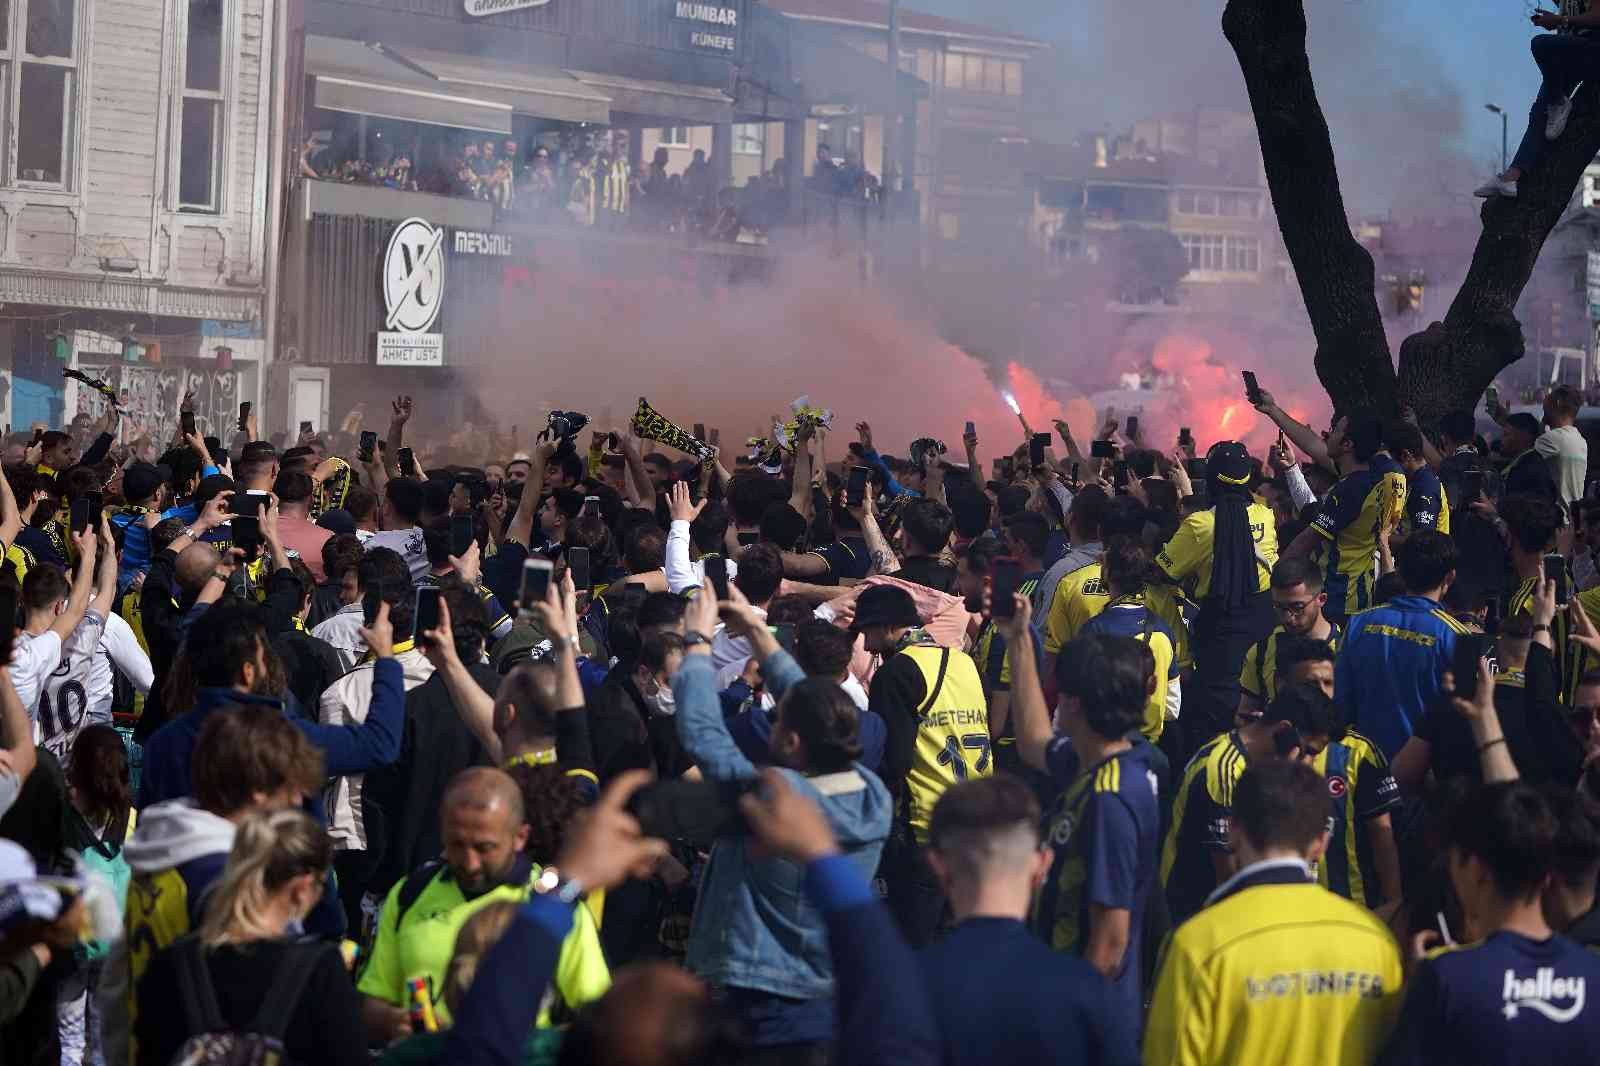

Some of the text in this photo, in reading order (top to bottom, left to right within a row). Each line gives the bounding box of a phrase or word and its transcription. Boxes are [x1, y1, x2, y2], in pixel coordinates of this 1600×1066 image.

[676, 1, 737, 25] MUMBAR
[382, 349, 438, 361] AHMET USTA
[38, 679, 88, 741] 10
[937, 733, 991, 781] 17
[1502, 966, 1586, 1023] halley
